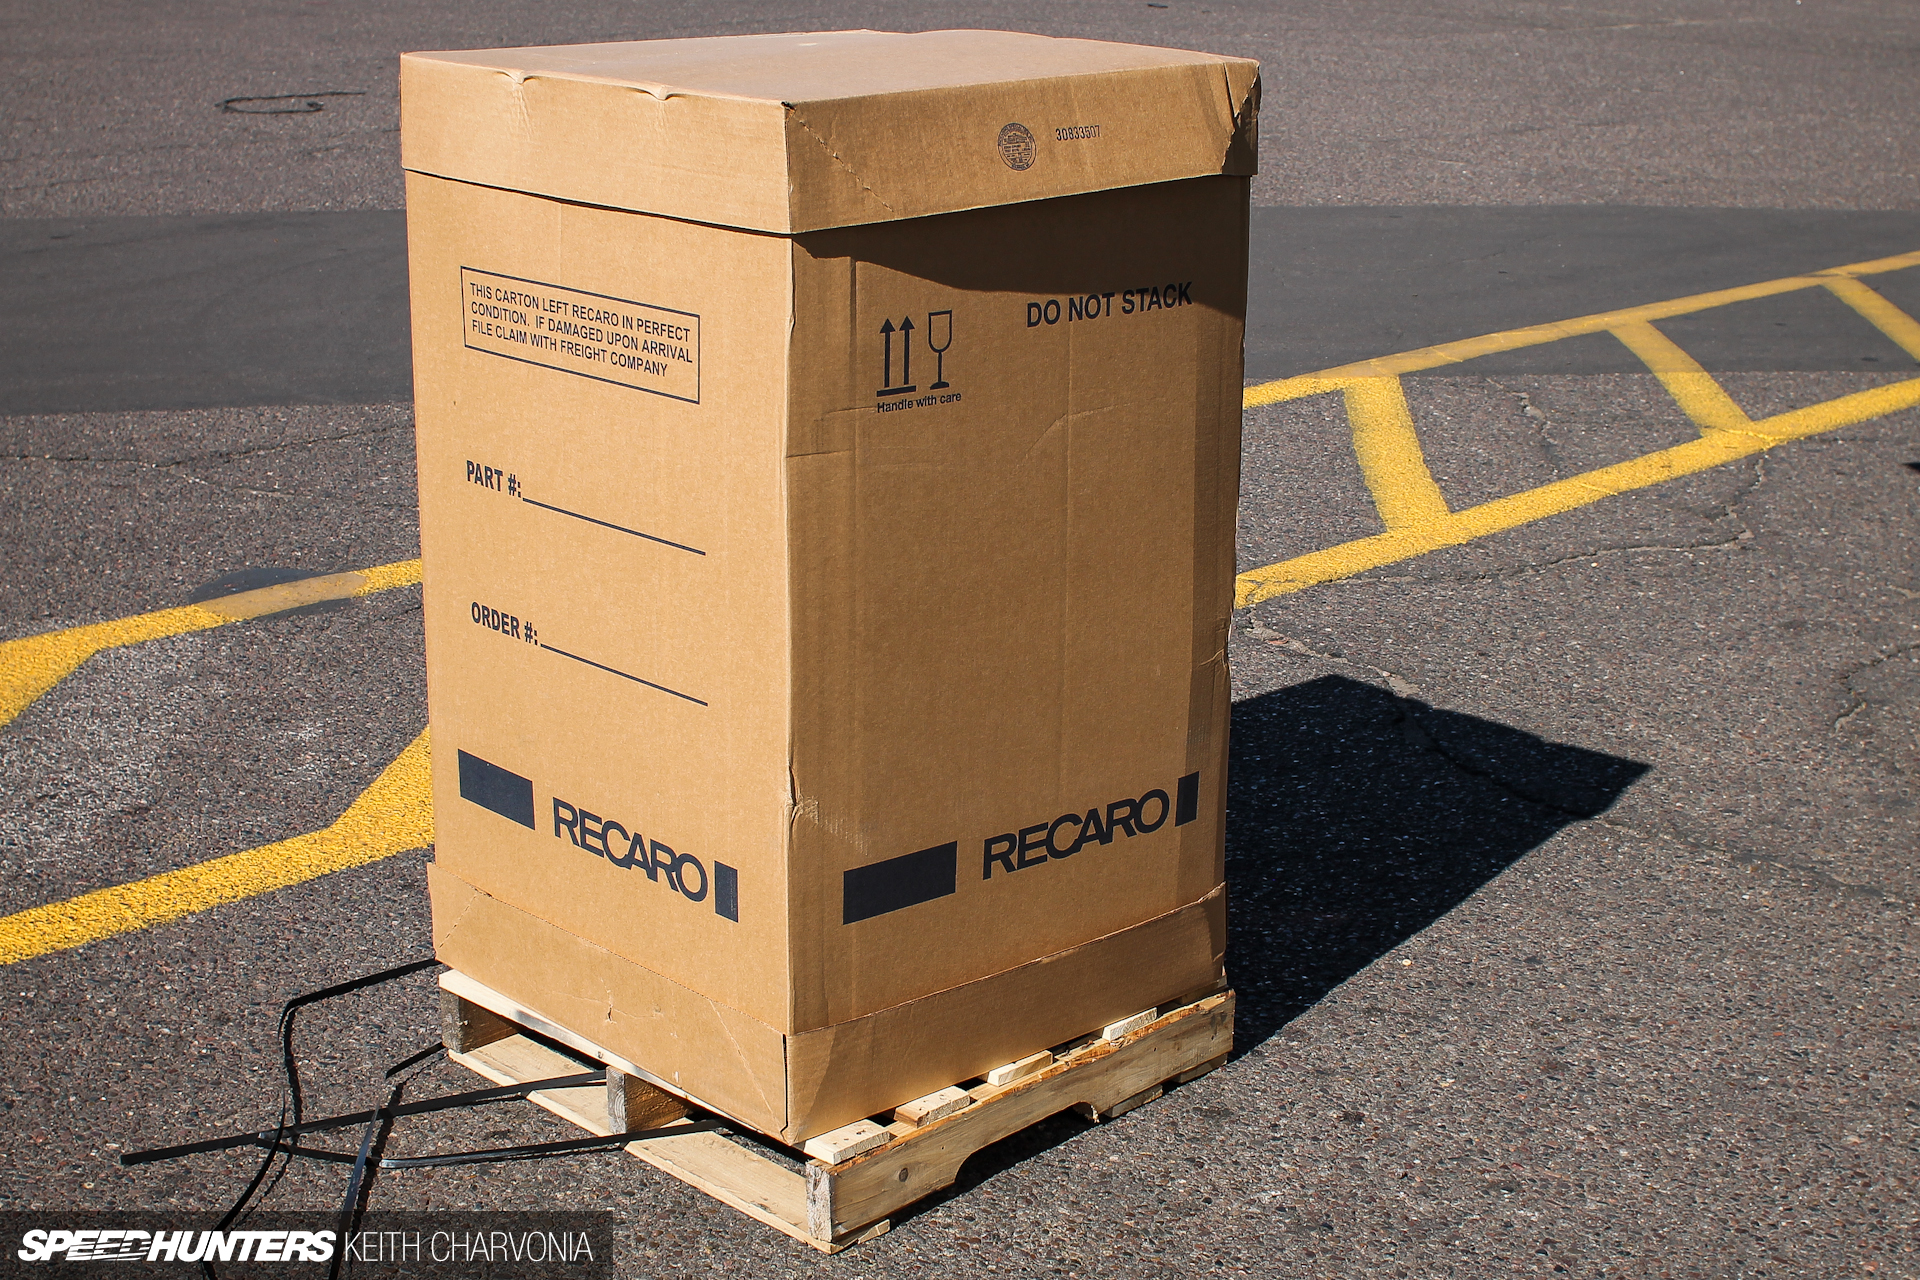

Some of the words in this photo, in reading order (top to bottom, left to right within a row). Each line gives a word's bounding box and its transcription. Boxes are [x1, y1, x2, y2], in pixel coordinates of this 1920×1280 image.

[1055, 124, 1101, 142] 30833507
[470, 282, 492, 299] THIS
[495, 288, 539, 310] CARTON
[542, 298, 569, 316] LEFT
[572, 305, 619, 327] RECARO
[622, 315, 633, 330] IN
[637, 318, 690, 342] PERFECT
[1027, 299, 1061, 327] DO
[1068, 292, 1115, 321] NOT
[1122, 281, 1193, 315] STACK
[471, 301, 530, 326] CONDITION.
[535, 315, 545, 329] IF
[548, 318, 603, 342] DAMAGED
[607, 330, 638, 351] UPON
[641, 338, 693, 363] ARRIVAL
[472, 319, 492, 337] FILE
[495, 325, 527, 345] CLAIM
[530, 333, 557, 352] WITH
[560, 340, 607, 363] FREIGHT
[610, 351, 668, 377] COMPANY
[877, 398, 914, 413] Handle
[916, 394, 937, 408] with
[940, 391, 961, 404] care
[466, 459, 503, 492] PART
[471, 601, 520, 640] ORDER
[553, 796, 708, 902] RECARO
[982, 788, 1170, 880] RECARO
